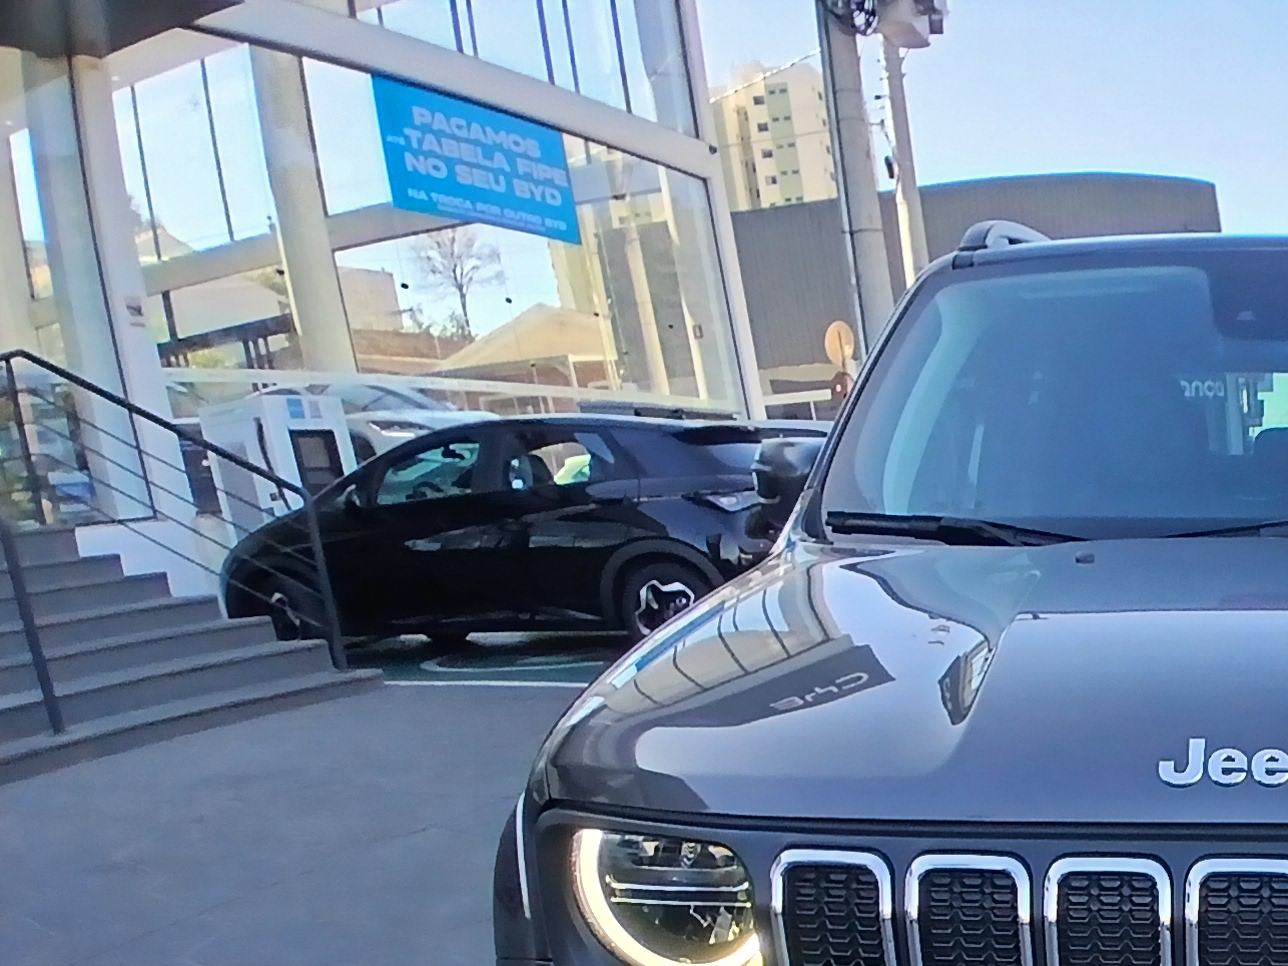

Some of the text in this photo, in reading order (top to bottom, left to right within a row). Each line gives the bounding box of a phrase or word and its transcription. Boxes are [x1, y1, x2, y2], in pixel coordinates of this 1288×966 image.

[403, 127, 511, 172] TABELA
[517, 158, 569, 187] FIPE
[412, 106, 541, 158] PAGAMOS
[404, 152, 563, 206] NO SEU BYD
[407, 188, 428, 201] NA
[431, 192, 473, 211] TROCA
